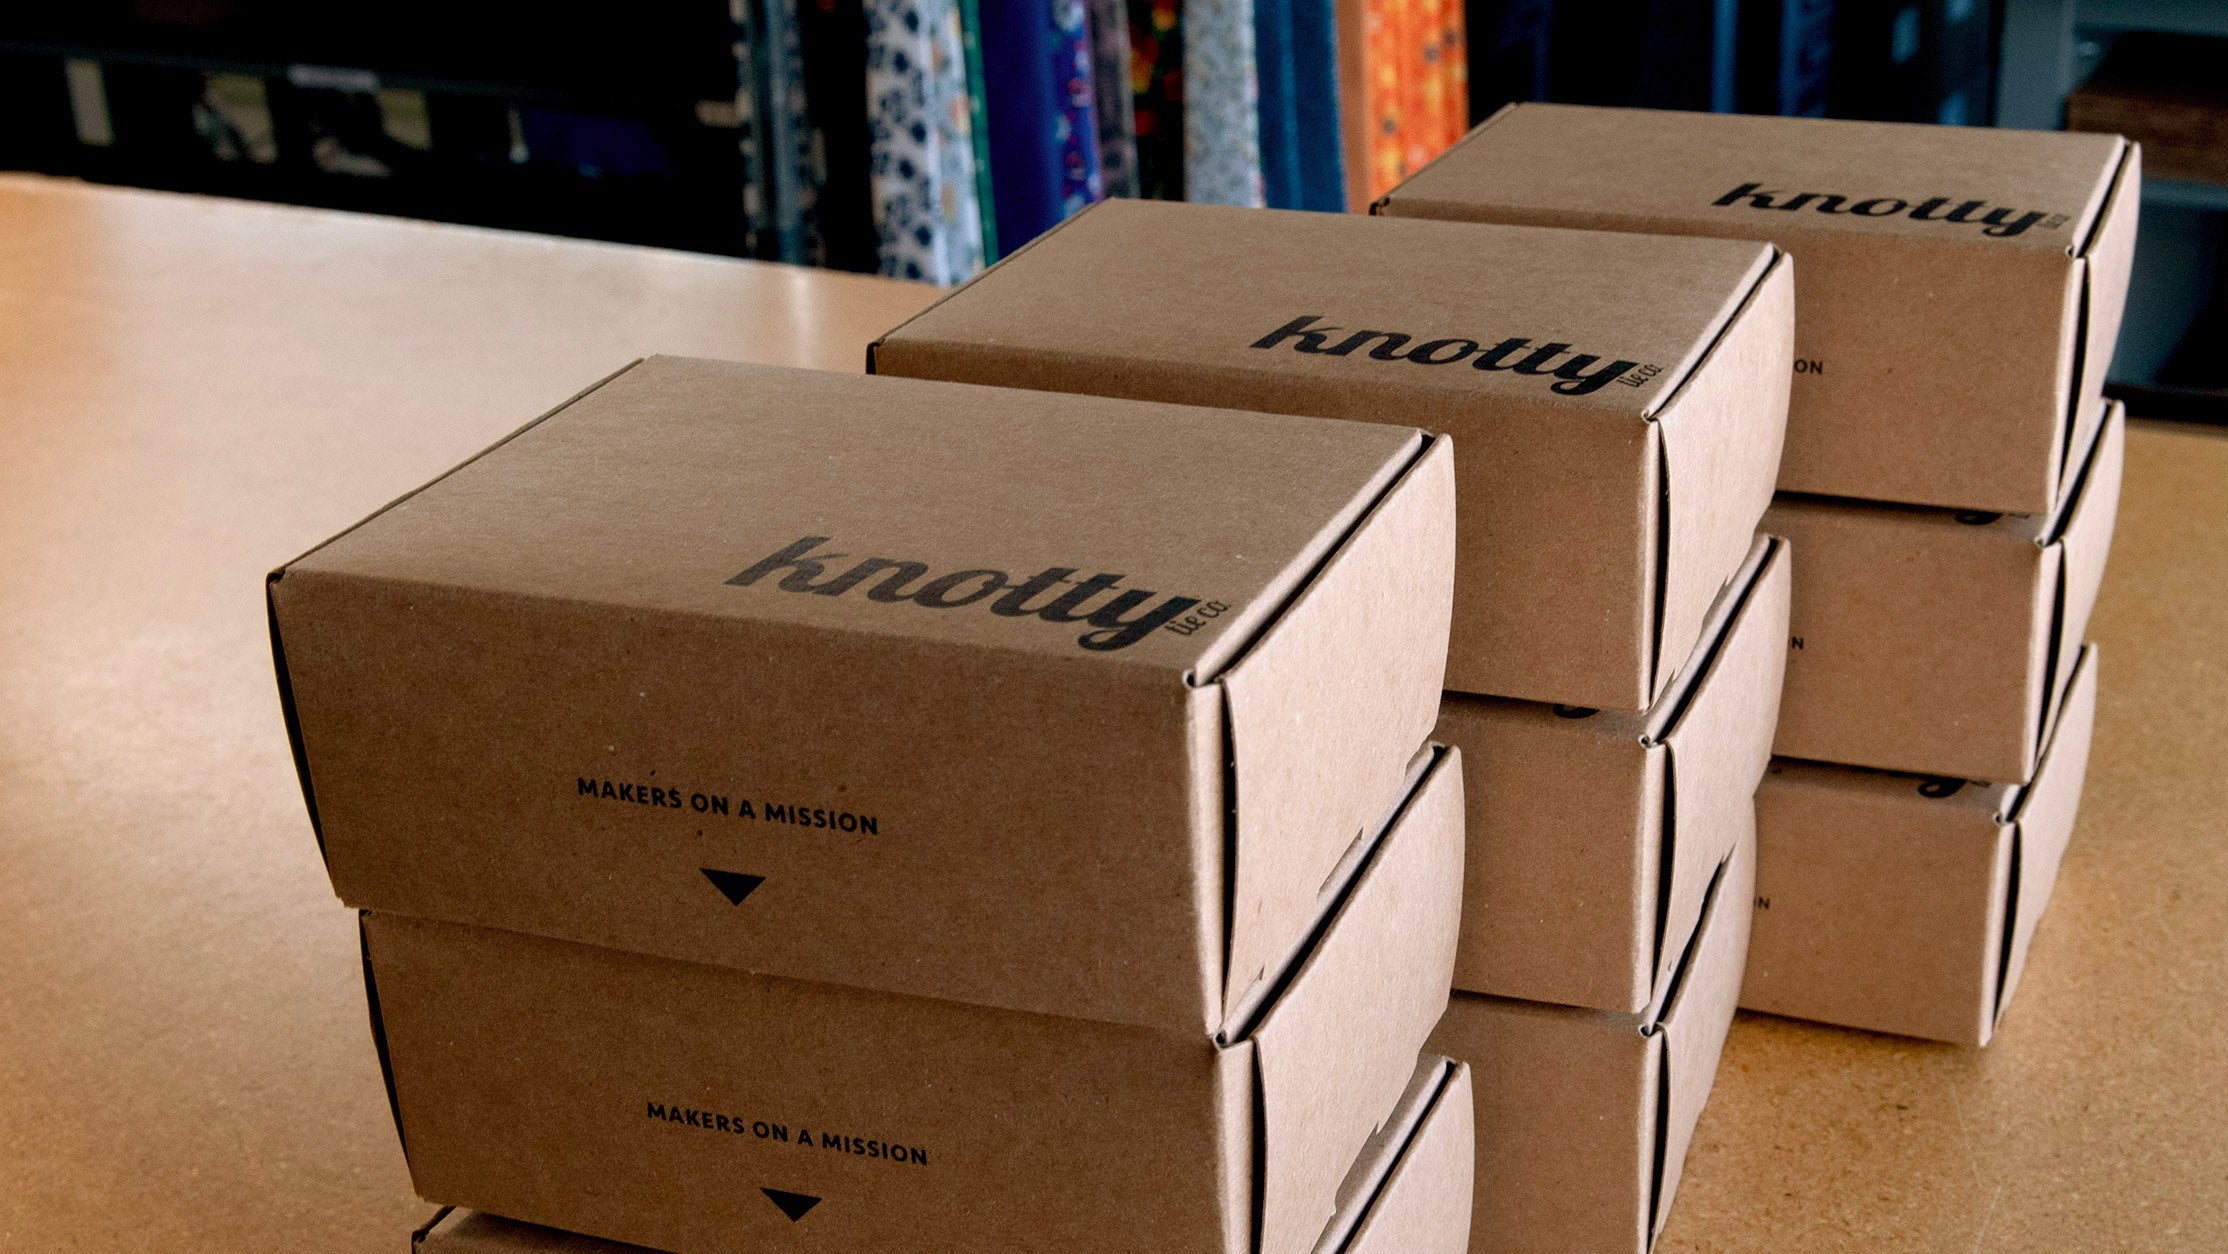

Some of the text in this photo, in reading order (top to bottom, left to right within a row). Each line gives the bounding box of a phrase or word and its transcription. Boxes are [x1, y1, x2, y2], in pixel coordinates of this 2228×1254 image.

[1711, 182, 2048, 237] knotty
[1248, 314, 1640, 396] knotty
[722, 535, 1203, 652] knotty
[1163, 615, 1206, 636] tie
[577, 777, 878, 836] MAKERS ON A MISSION
[646, 1102, 928, 1166] MAKERS ON A MISSION
